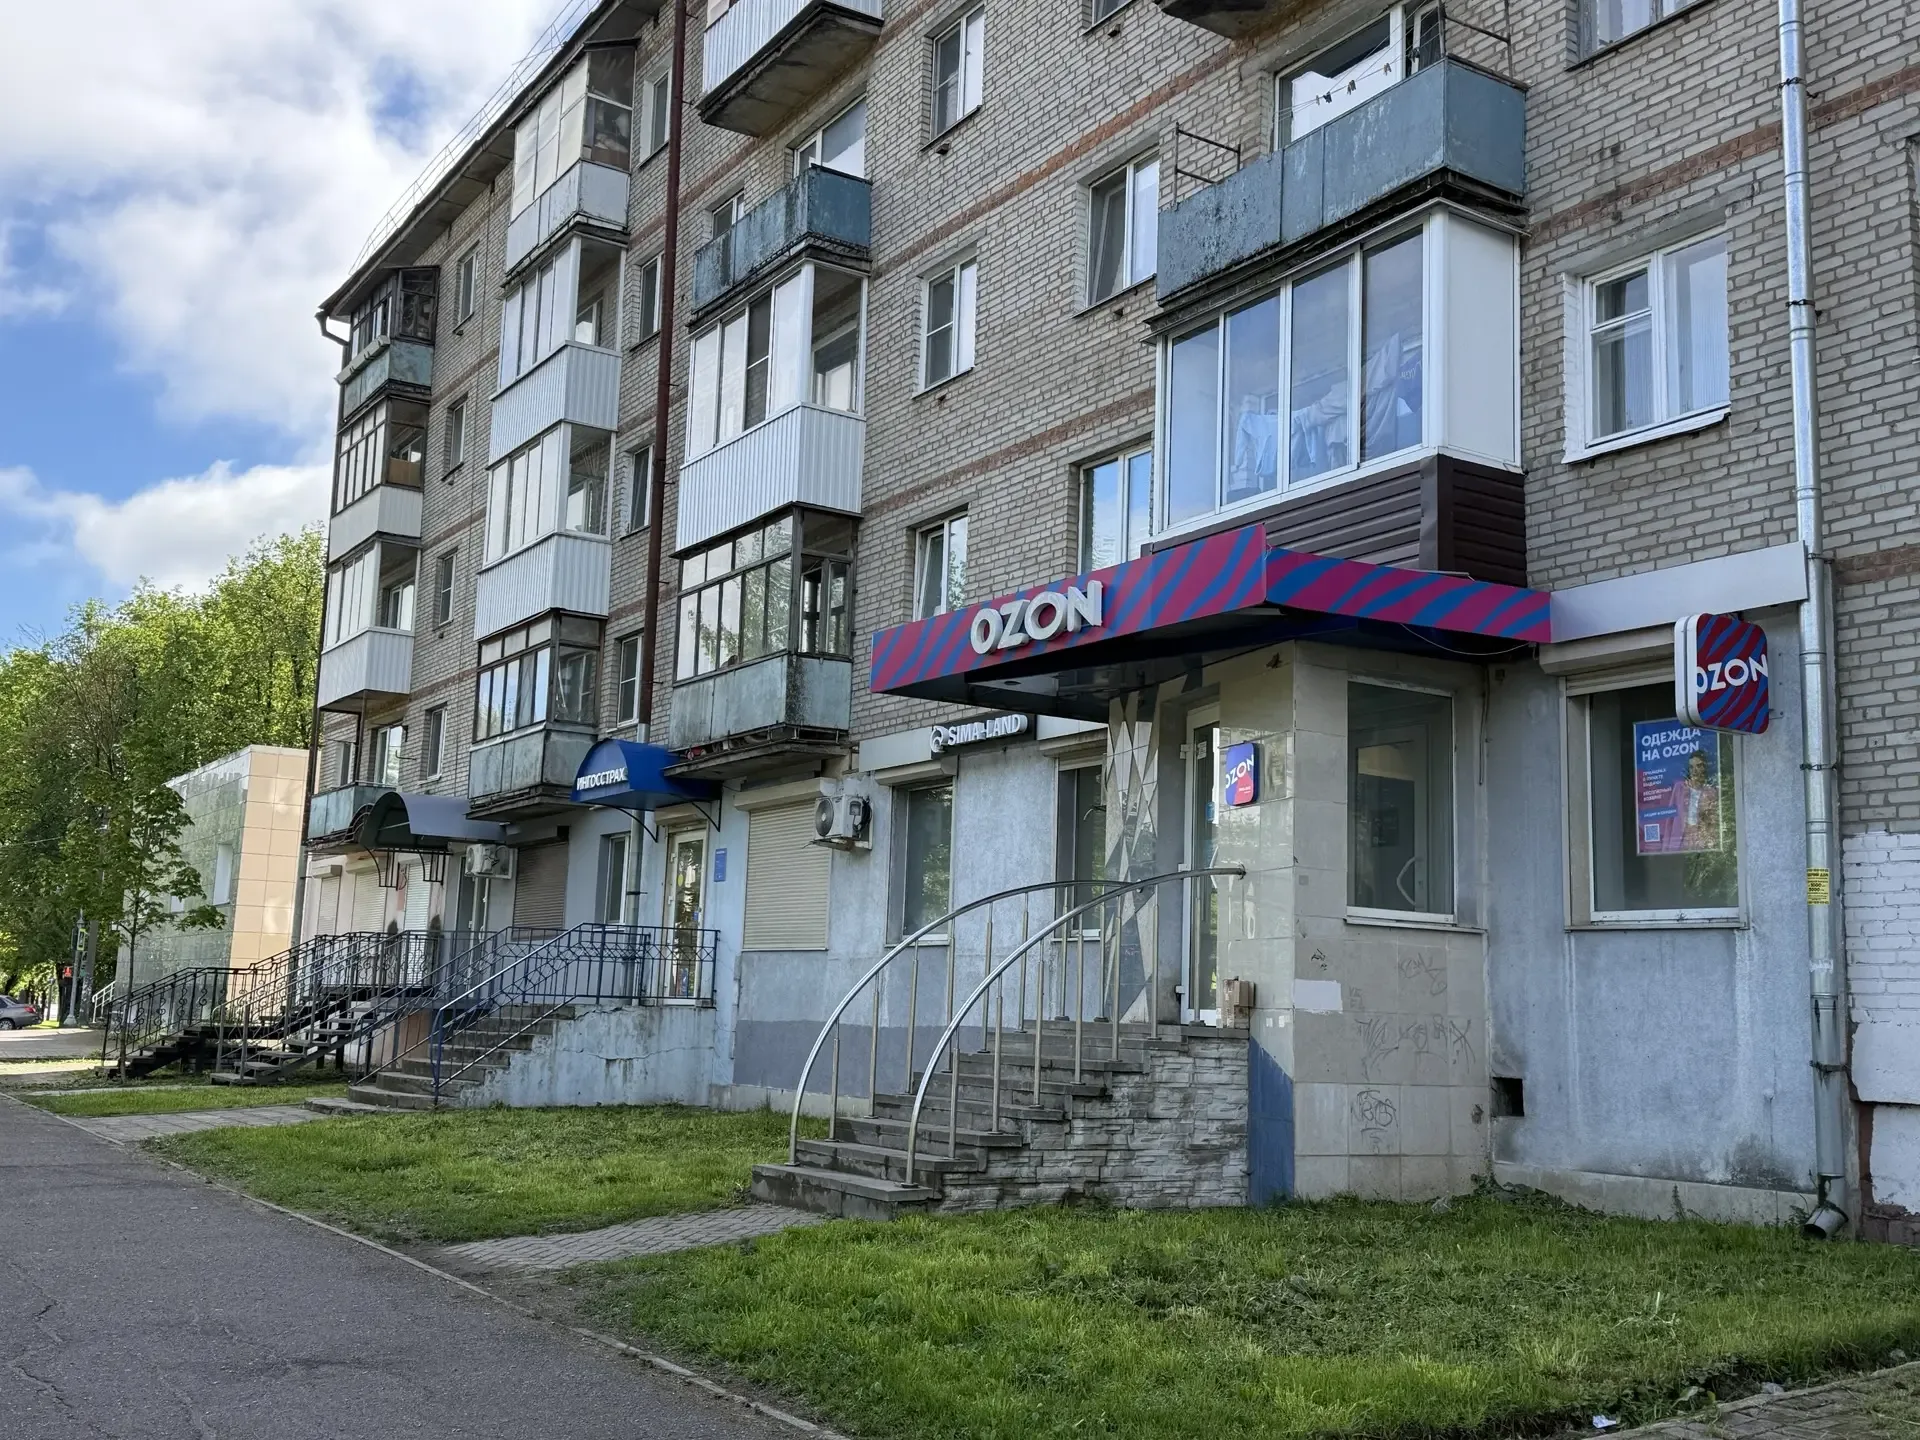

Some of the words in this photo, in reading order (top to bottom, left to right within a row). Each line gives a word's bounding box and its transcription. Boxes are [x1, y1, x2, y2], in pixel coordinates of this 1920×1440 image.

[970, 579, 1104, 655] OZON
[947, 713, 1028, 745] SIMA-LAND
[1641, 727, 1702, 747] ОДЕЖДА
[1641, 749, 1659, 762] НА
[1663, 740, 1700, 758] OZON
[577, 768, 626, 791] ИНГОССТРАХ
